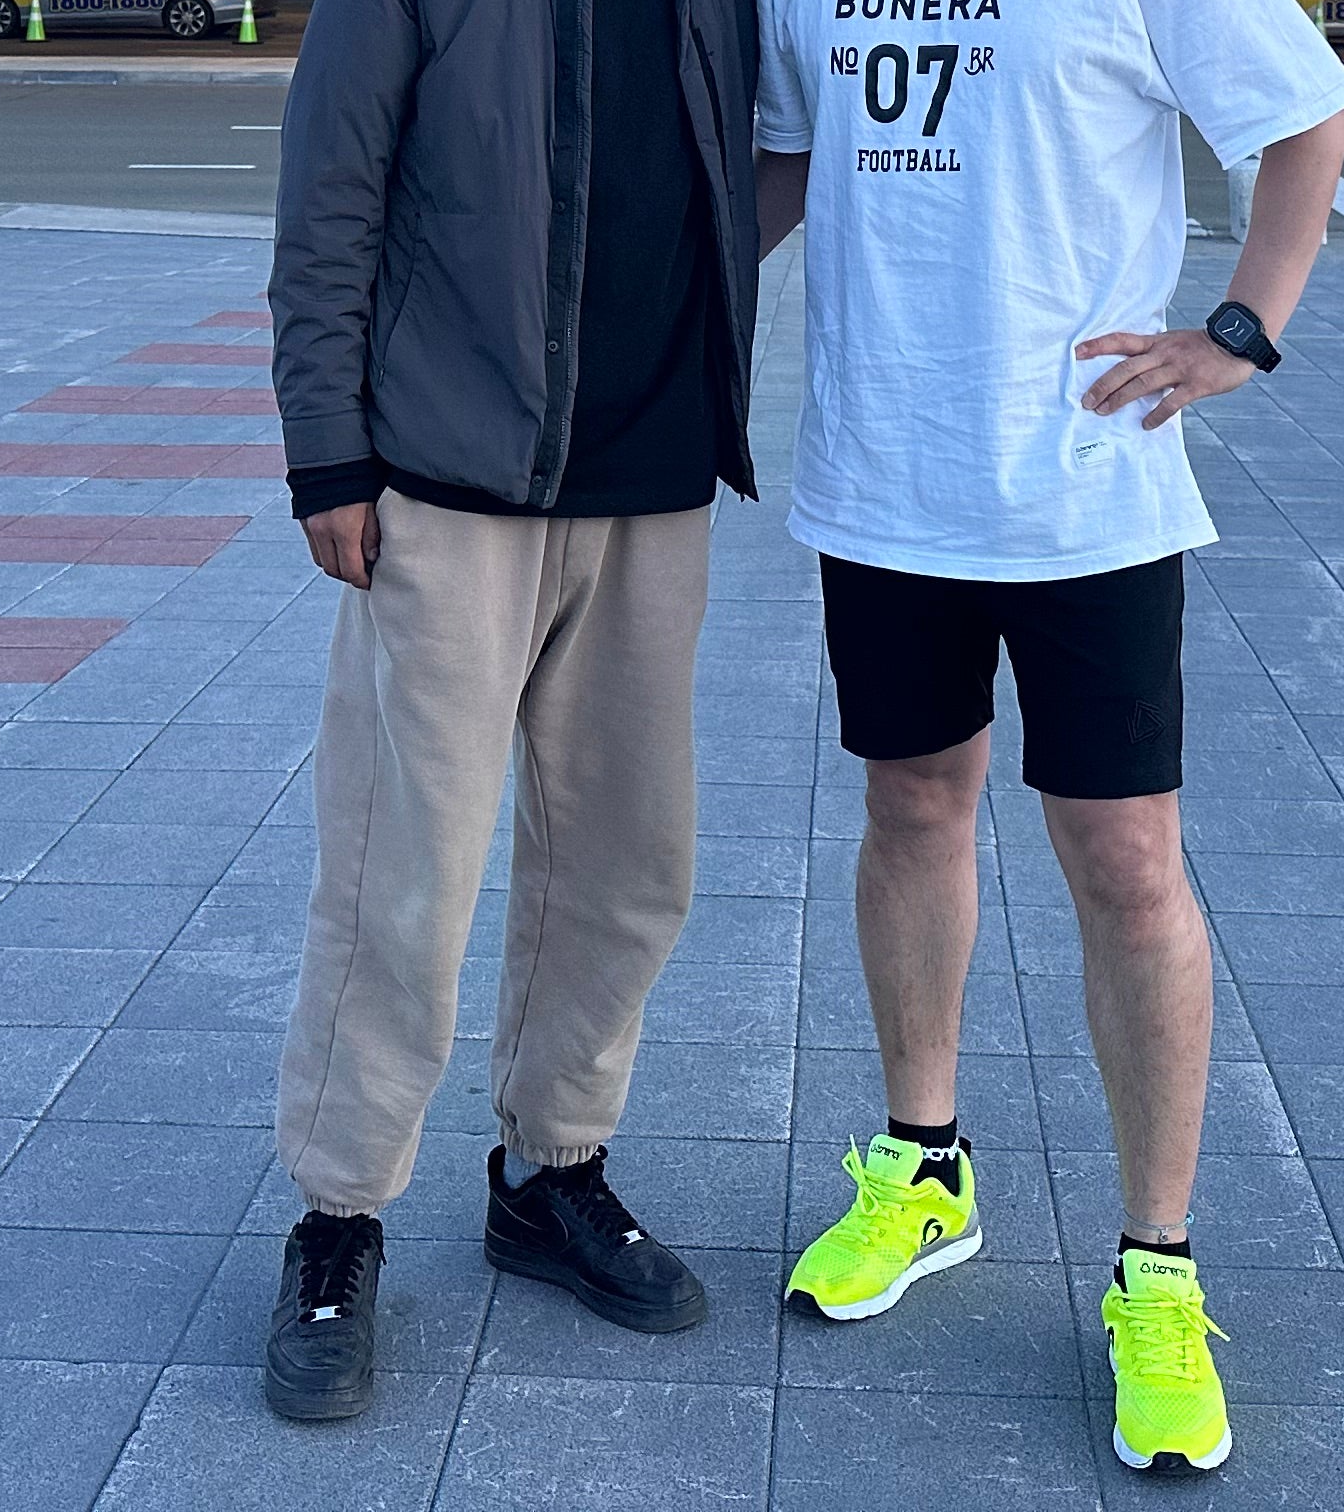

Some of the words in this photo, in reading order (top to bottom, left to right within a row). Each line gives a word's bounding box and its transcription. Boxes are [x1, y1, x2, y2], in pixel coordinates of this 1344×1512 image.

[864, 43, 960, 137] 07
[963, 46, 995, 76] BR
[857, 148, 961, 173] FOOTBALL
